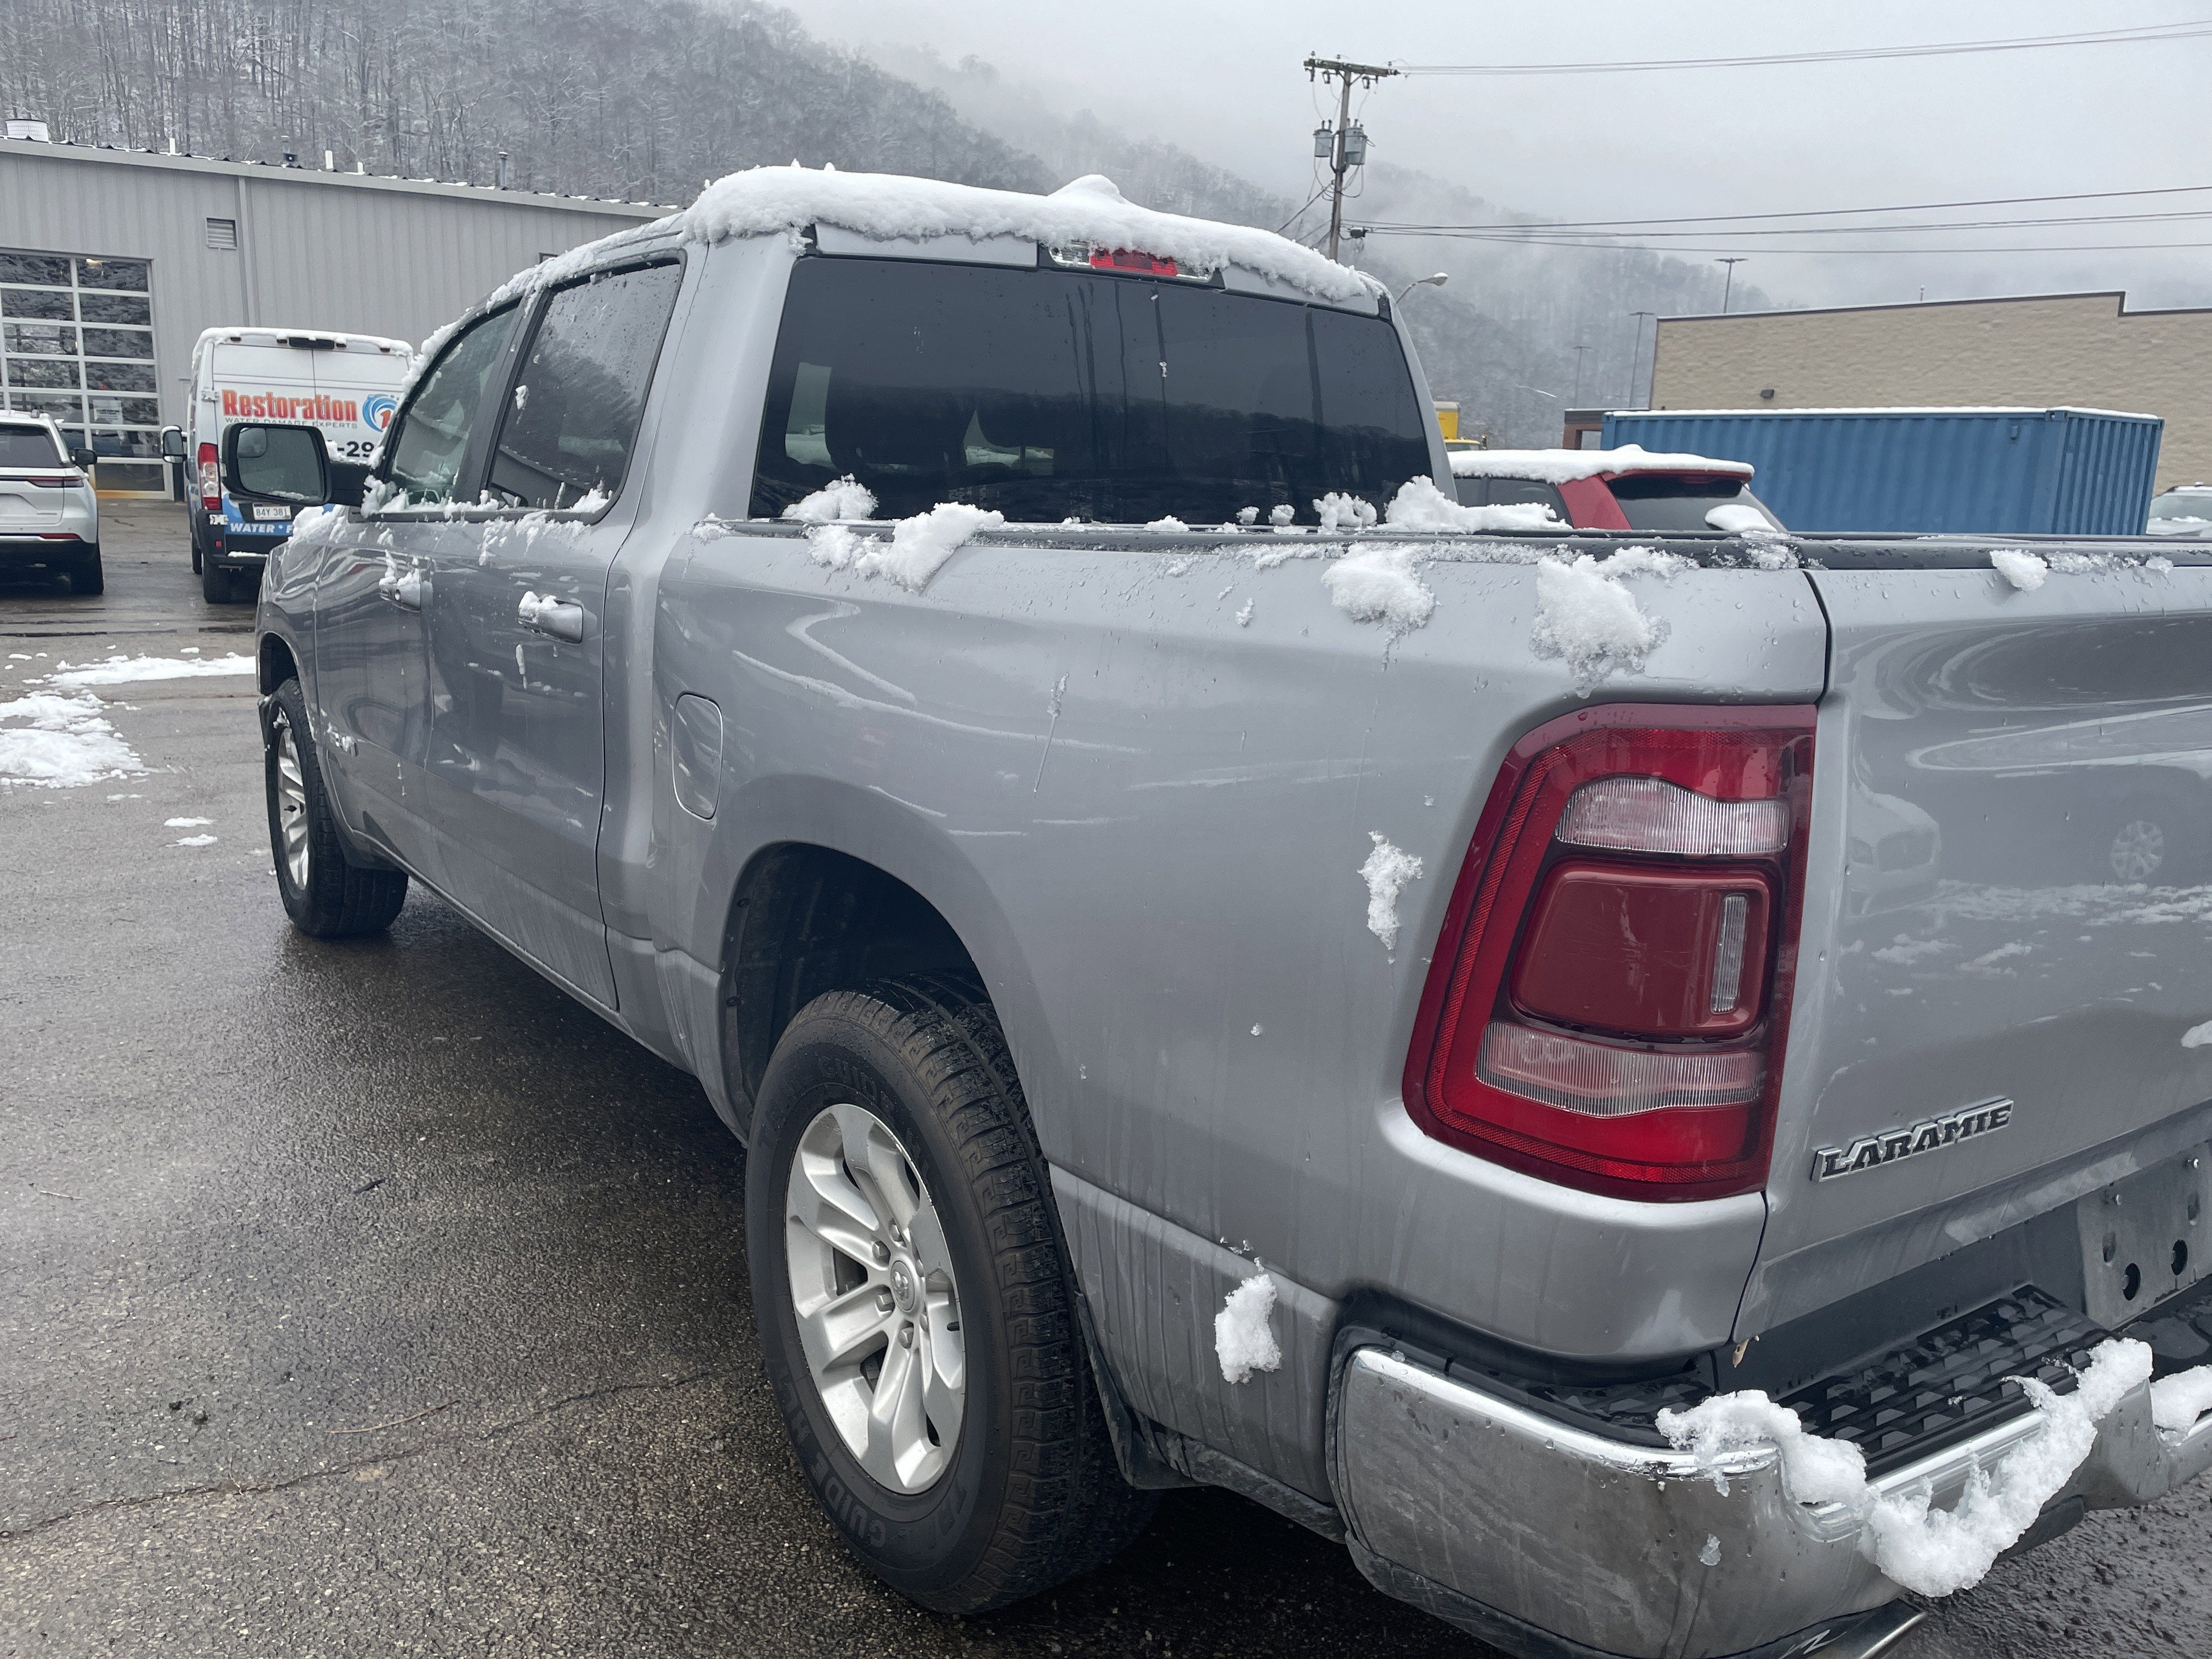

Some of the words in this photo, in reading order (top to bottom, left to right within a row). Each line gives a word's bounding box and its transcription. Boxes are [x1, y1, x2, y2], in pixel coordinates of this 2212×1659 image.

[222, 389, 357, 422] Restoration
[230, 523, 275, 533] WATER
[273, 507, 287, 516] 381
[1812, 1099, 2014, 1182] LARAMIE
[810, 1451, 887, 1548] GUIDE
